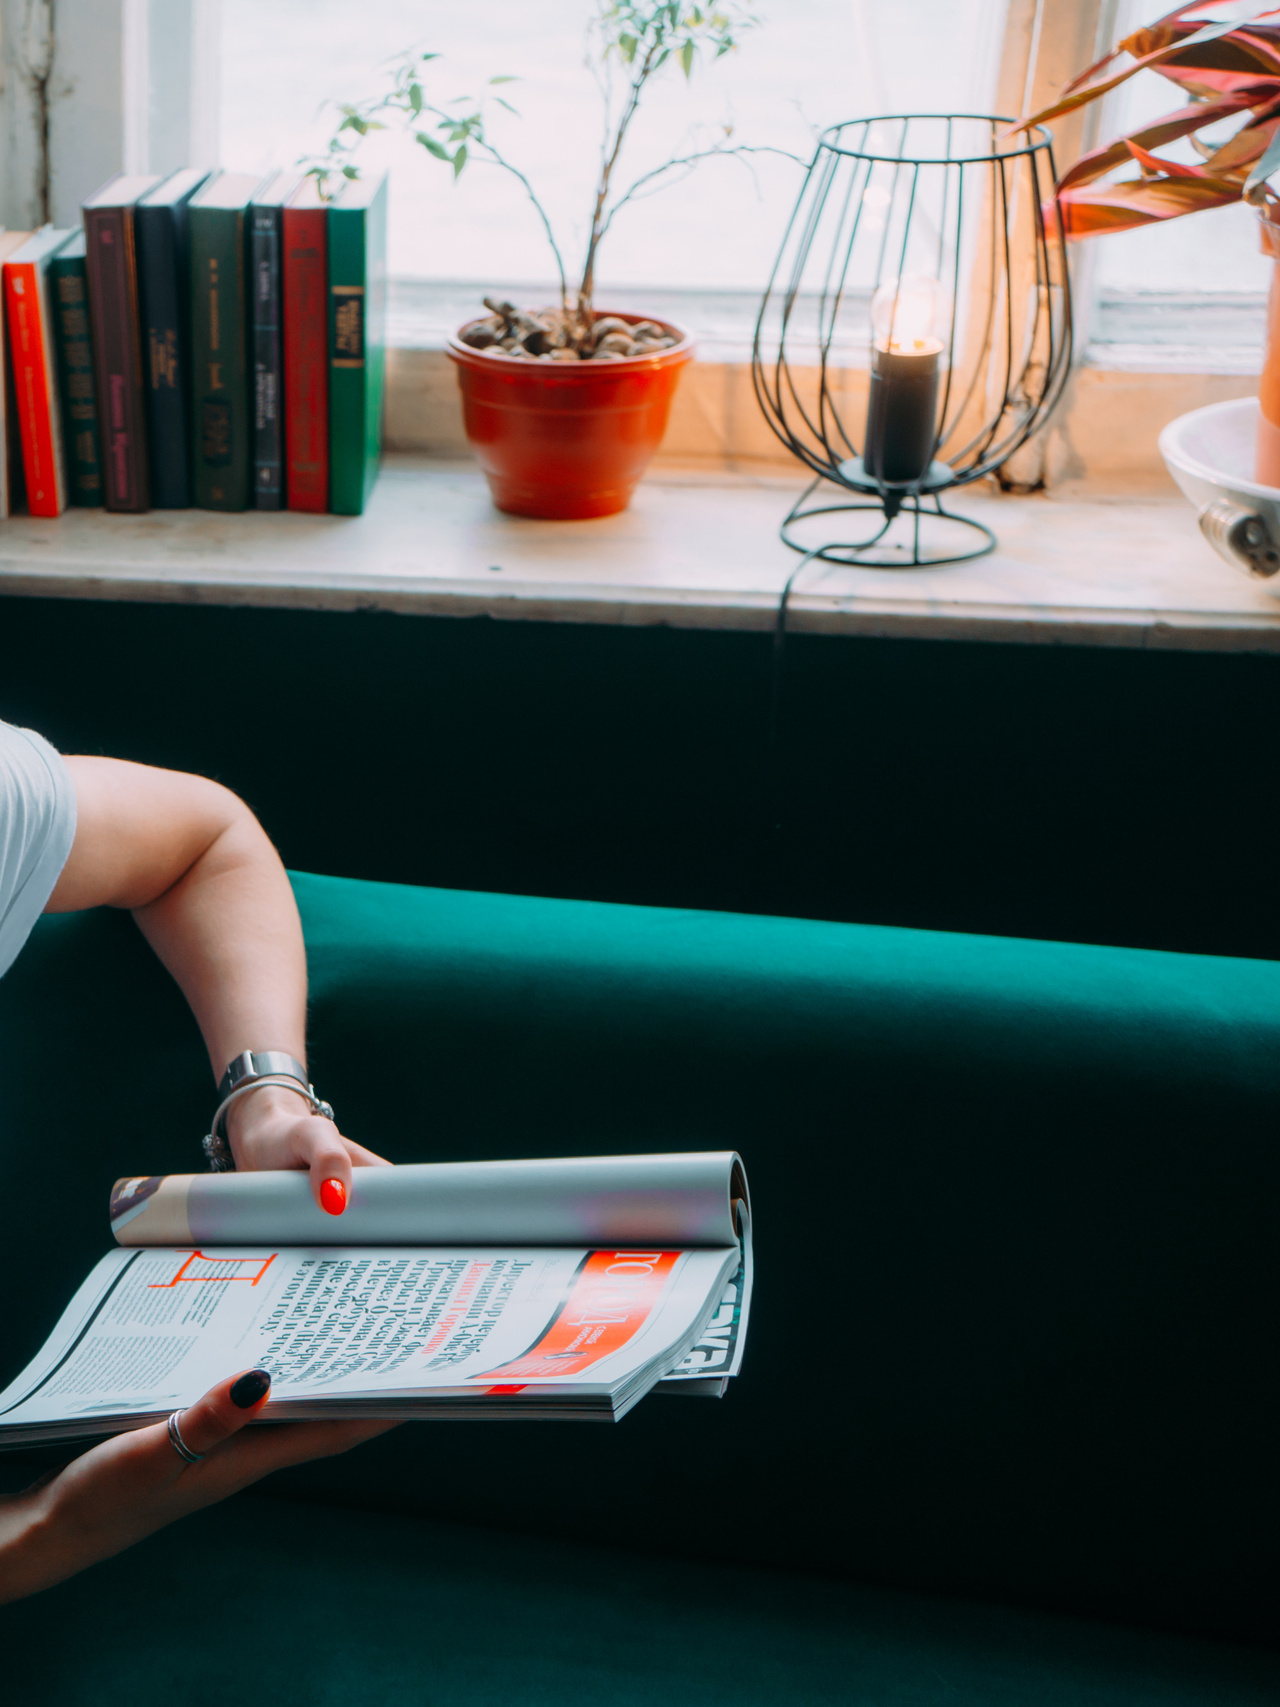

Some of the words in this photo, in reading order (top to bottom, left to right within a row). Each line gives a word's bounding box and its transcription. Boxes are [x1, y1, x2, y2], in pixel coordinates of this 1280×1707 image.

[281, 1270, 310, 1299] этом
[329, 1260, 352, 1283] еще
[334, 1260, 372, 1309] просьбе
[375, 1260, 410, 1301] привез
[393, 1260, 429, 1305] открыл
[412, 1260, 454, 1303] Триера
[454, 1259, 494, 1303] Даниил
[466, 1260, 509, 1319] компании
[484, 1259, 533, 1316] Директор
[567, 1252, 662, 1327] ГОРОД
[304, 1286, 340, 1327] ждать
[338, 1268, 391, 1333] Петербург
[412, 1260, 470, 1338] прокатывает
[267, 1334, 295, 1352] что
[352, 1306, 390, 1341] Озона
[368, 1309, 408, 1349] России
[421, 1308, 469, 1354] Горошко
[444, 1322, 478, 1351] A-One
[319, 1347, 344, 1358] по
